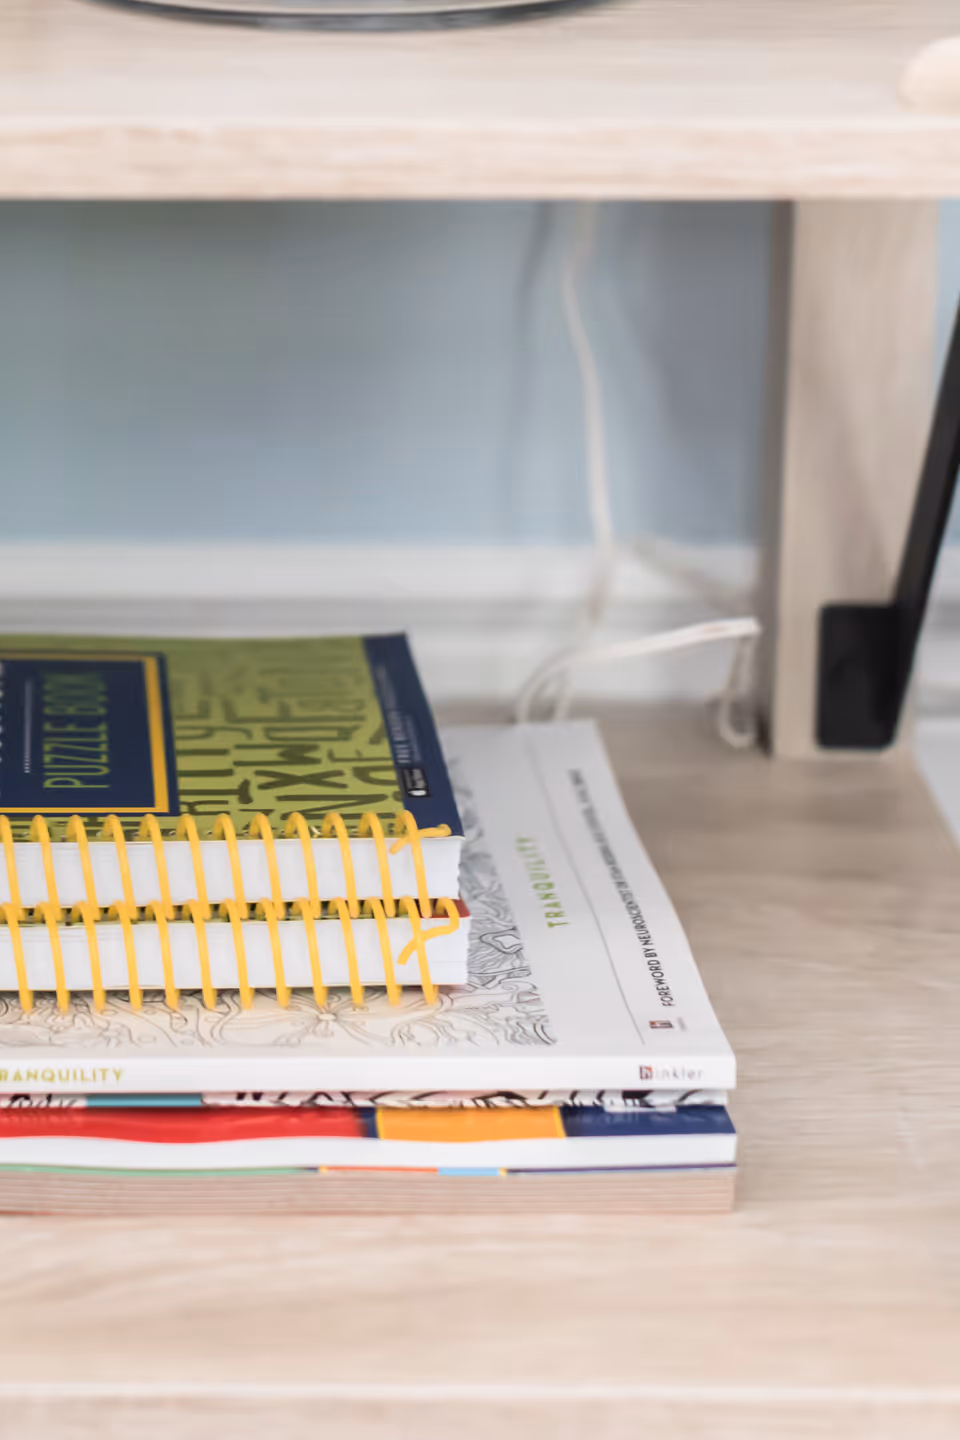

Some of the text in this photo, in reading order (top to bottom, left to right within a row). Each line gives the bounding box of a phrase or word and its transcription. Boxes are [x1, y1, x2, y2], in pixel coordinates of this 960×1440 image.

[43, 672, 110, 789] PUZZLE BOOK
[516, 836, 569, 928] TRANQUILITY
[642, 947, 658, 958] BY
[647, 959, 676, 1007] FOREWORD
